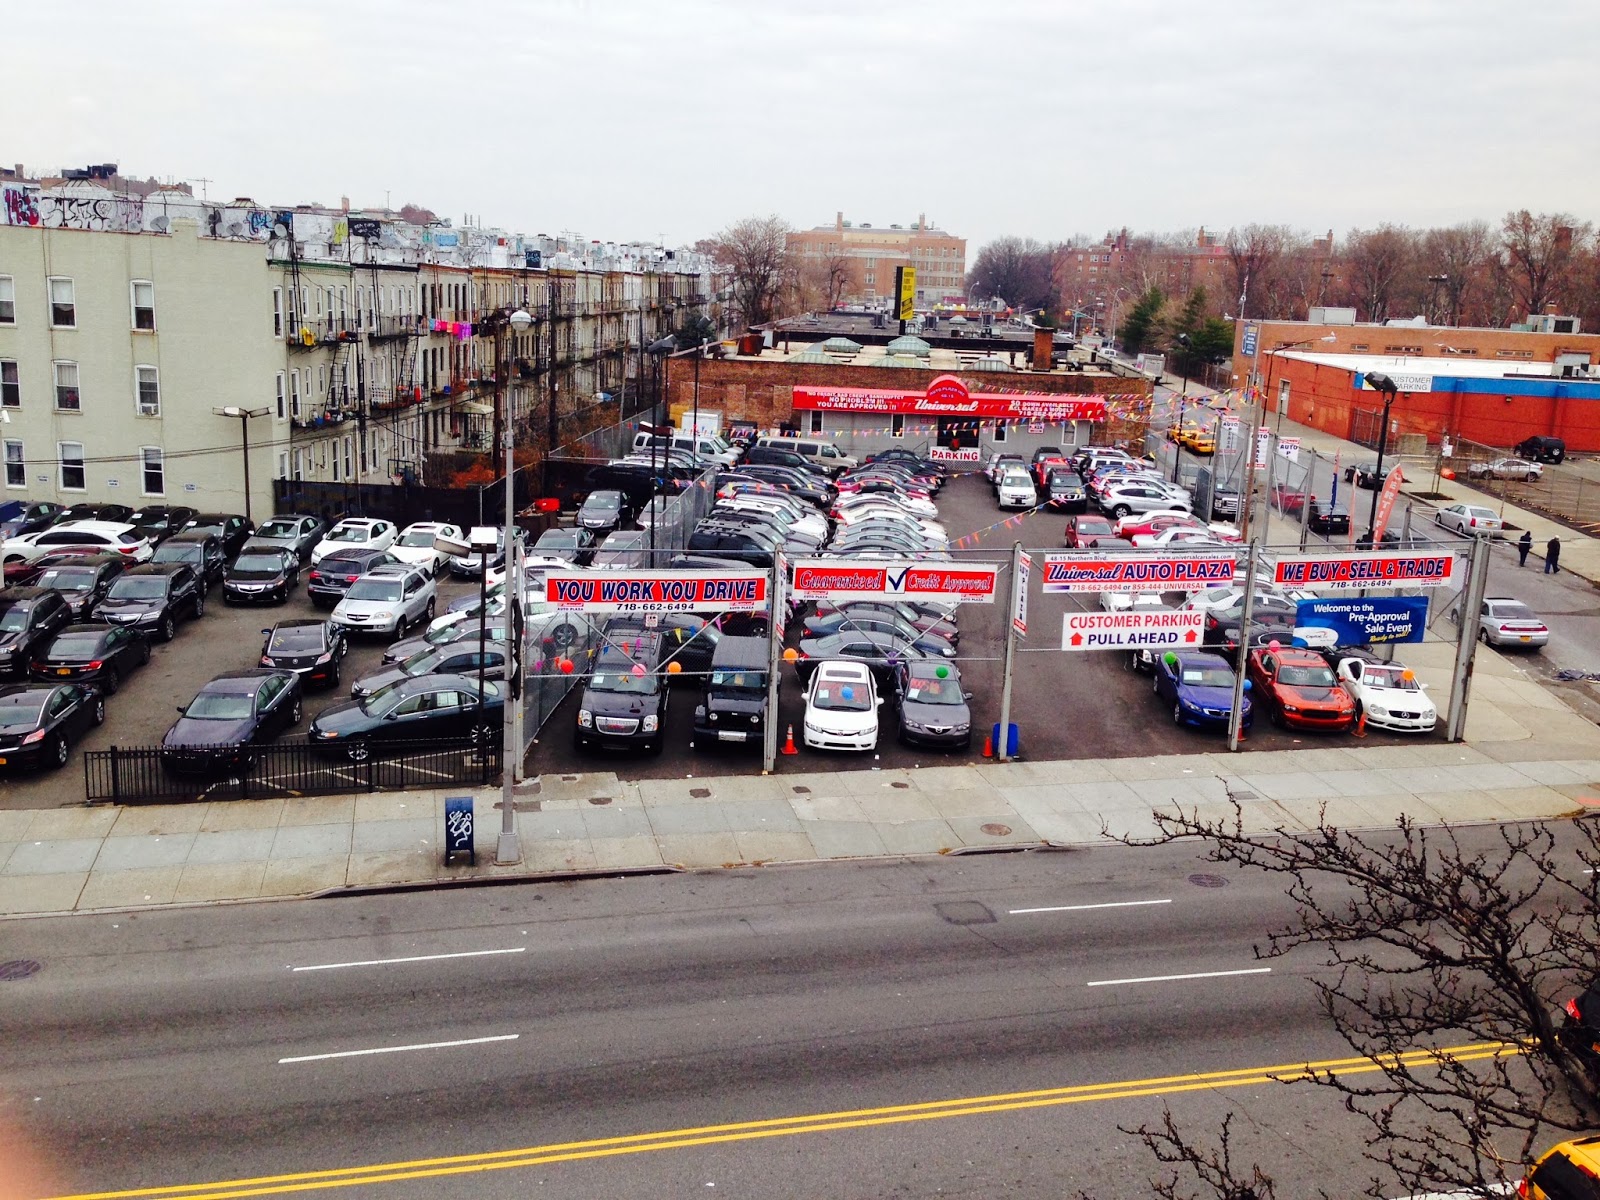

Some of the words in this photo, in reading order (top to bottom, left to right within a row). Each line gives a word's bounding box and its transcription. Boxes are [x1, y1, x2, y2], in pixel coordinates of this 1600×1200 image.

[849, 402, 888, 410] APPROVED
[915, 399, 979, 412] Universal
[932, 450, 979, 461] PARKING
[1048, 563, 1123, 582] Universal
[1123, 563, 1172, 579] AUTO
[1174, 562, 1232, 578] PLAZA
[1282, 563, 1306, 581] WE
[1349, 561, 1384, 579] SELL
[1386, 563, 1394, 575] &
[1397, 558, 1446, 577] TRADE
[799, 569, 883, 591] Guaranteed
[907, 572, 940, 589] Credit
[941, 573, 991, 593] Approval
[556, 580, 594, 602] YOU
[601, 580, 656, 601] WORK
[660, 580, 698, 601] YOU
[703, 579, 758, 600] DRIVE
[1132, 582, 1205, 591] 855-444-UNIVERSAL
[616, 603, 695, 611] 718-662-6494
[1313, 604, 1351, 613] Welcome
[1353, 604, 1361, 612] to
[1362, 604, 1375, 612] the
[1069, 614, 1143, 629] CUSTOMER
[1144, 613, 1202, 627] PARKING
[1349, 611, 1410, 622] Pre-Approval
[1365, 623, 1385, 633] Sale
[1386, 623, 1413, 633] Event
[1088, 633, 1124, 645] PULL
[1125, 632, 1178, 645] AHEAD
[1369, 634, 1388, 643] Ready
